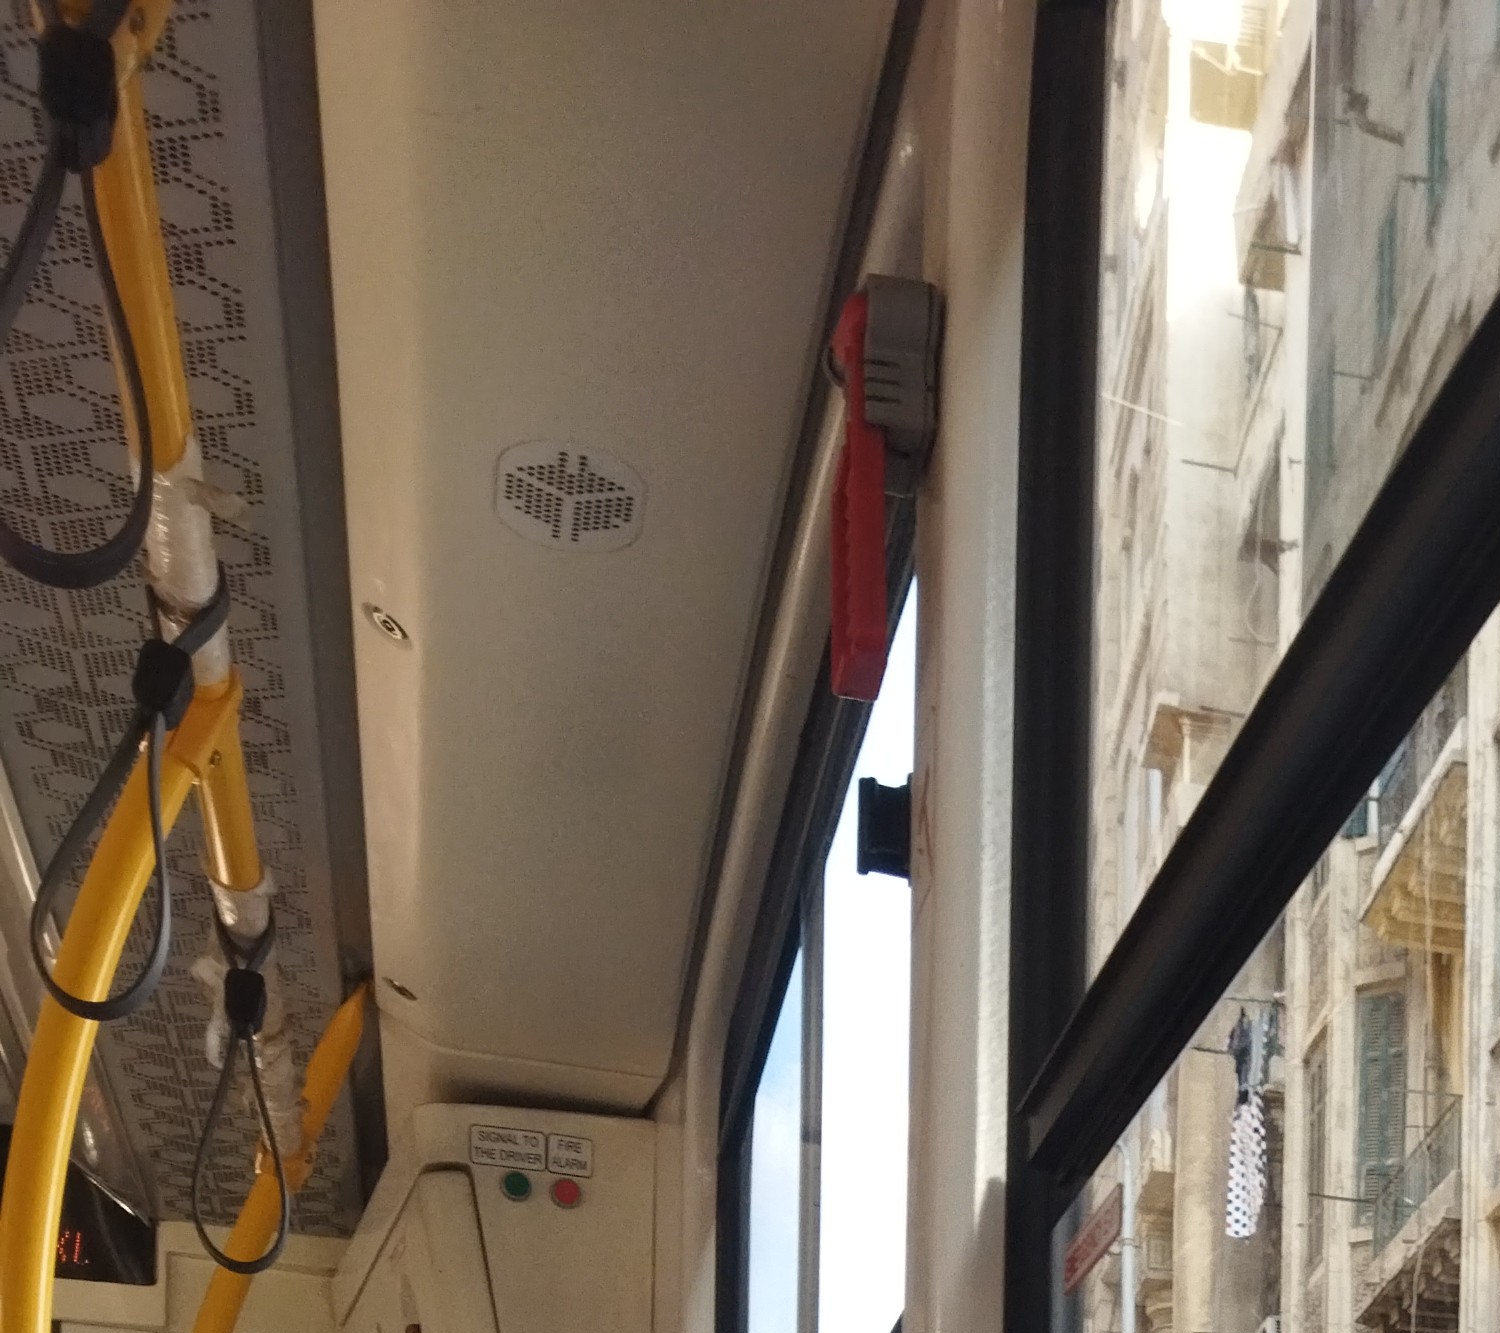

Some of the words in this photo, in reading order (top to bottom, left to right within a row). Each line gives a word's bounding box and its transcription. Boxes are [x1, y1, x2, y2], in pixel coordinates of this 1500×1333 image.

[477, 1130, 519, 1146] SIGNAL
[522, 1134, 540, 1148] TO
[558, 1139, 582, 1154] FIRE
[473, 1145, 497, 1160] THE
[499, 1149, 543, 1166] DRIVER
[551, 1156, 588, 1171] ALARM
